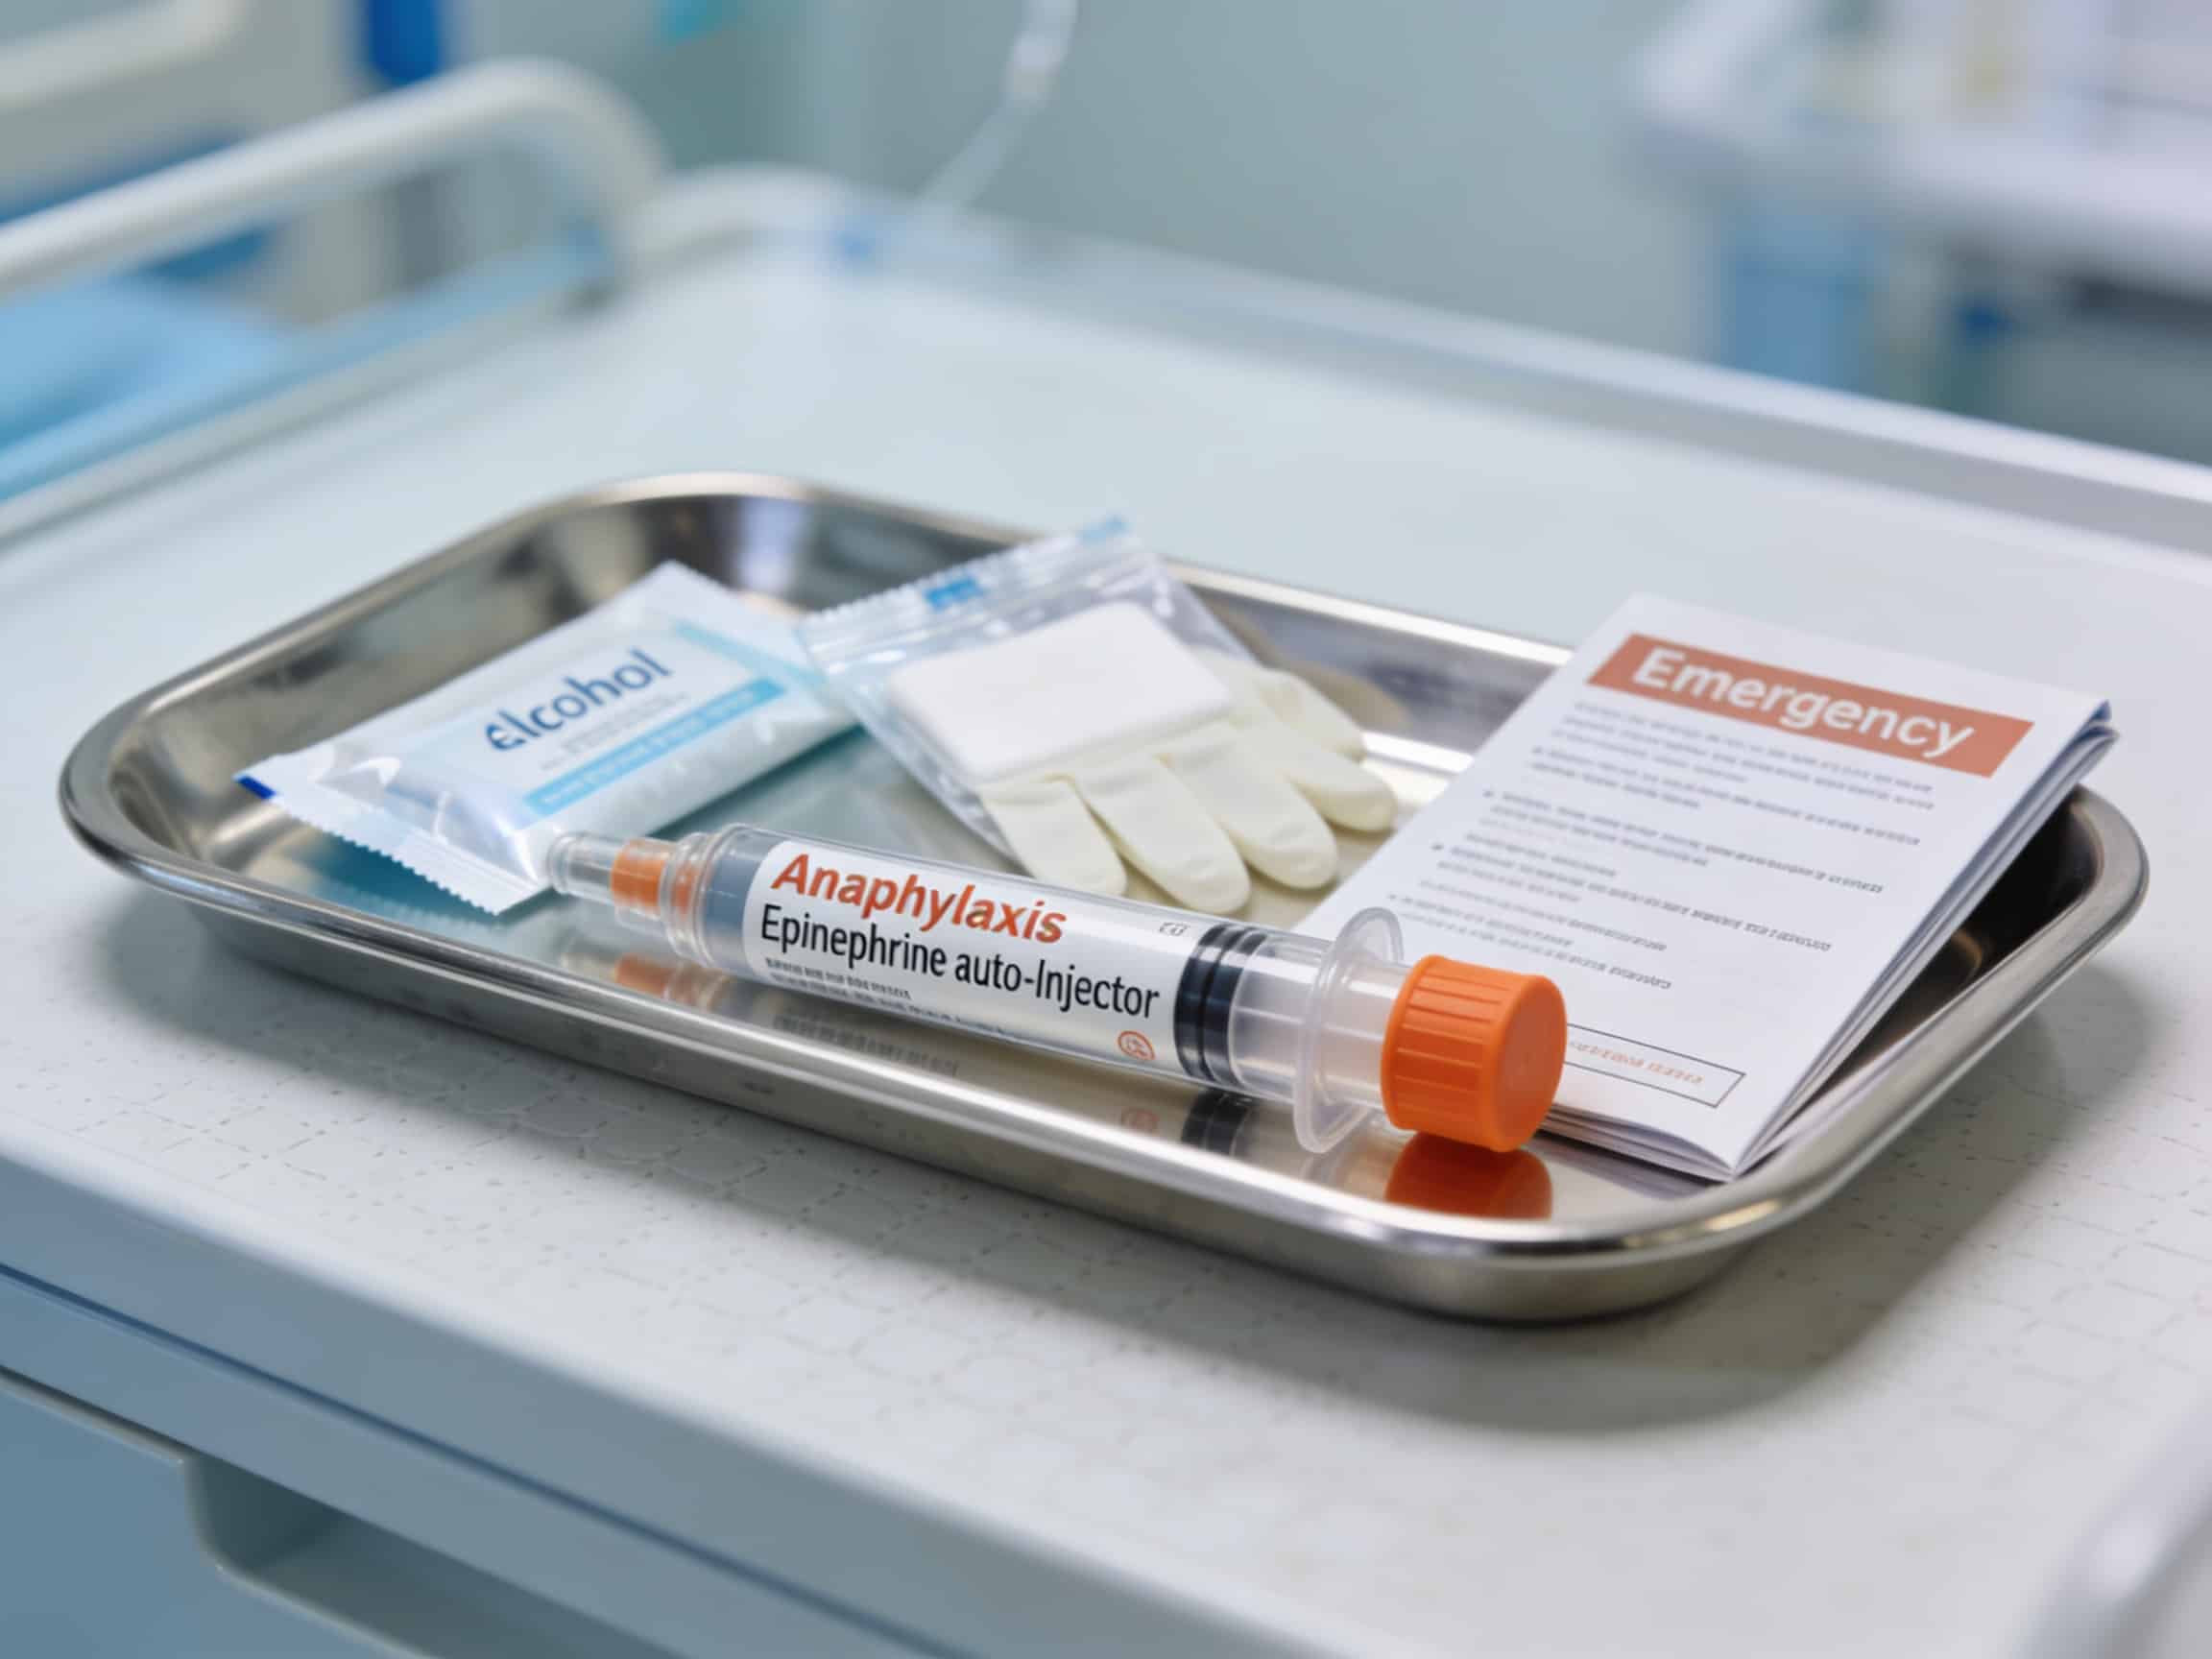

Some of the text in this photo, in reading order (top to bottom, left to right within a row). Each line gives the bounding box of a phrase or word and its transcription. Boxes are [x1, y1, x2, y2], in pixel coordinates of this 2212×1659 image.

[1634, 646, 1973, 758] Emergency
[771, 854, 1067, 943] Anaphylaxis
[761, 903, 947, 976] Epinephrine
[954, 953, 1160, 1019] auto-Injector
